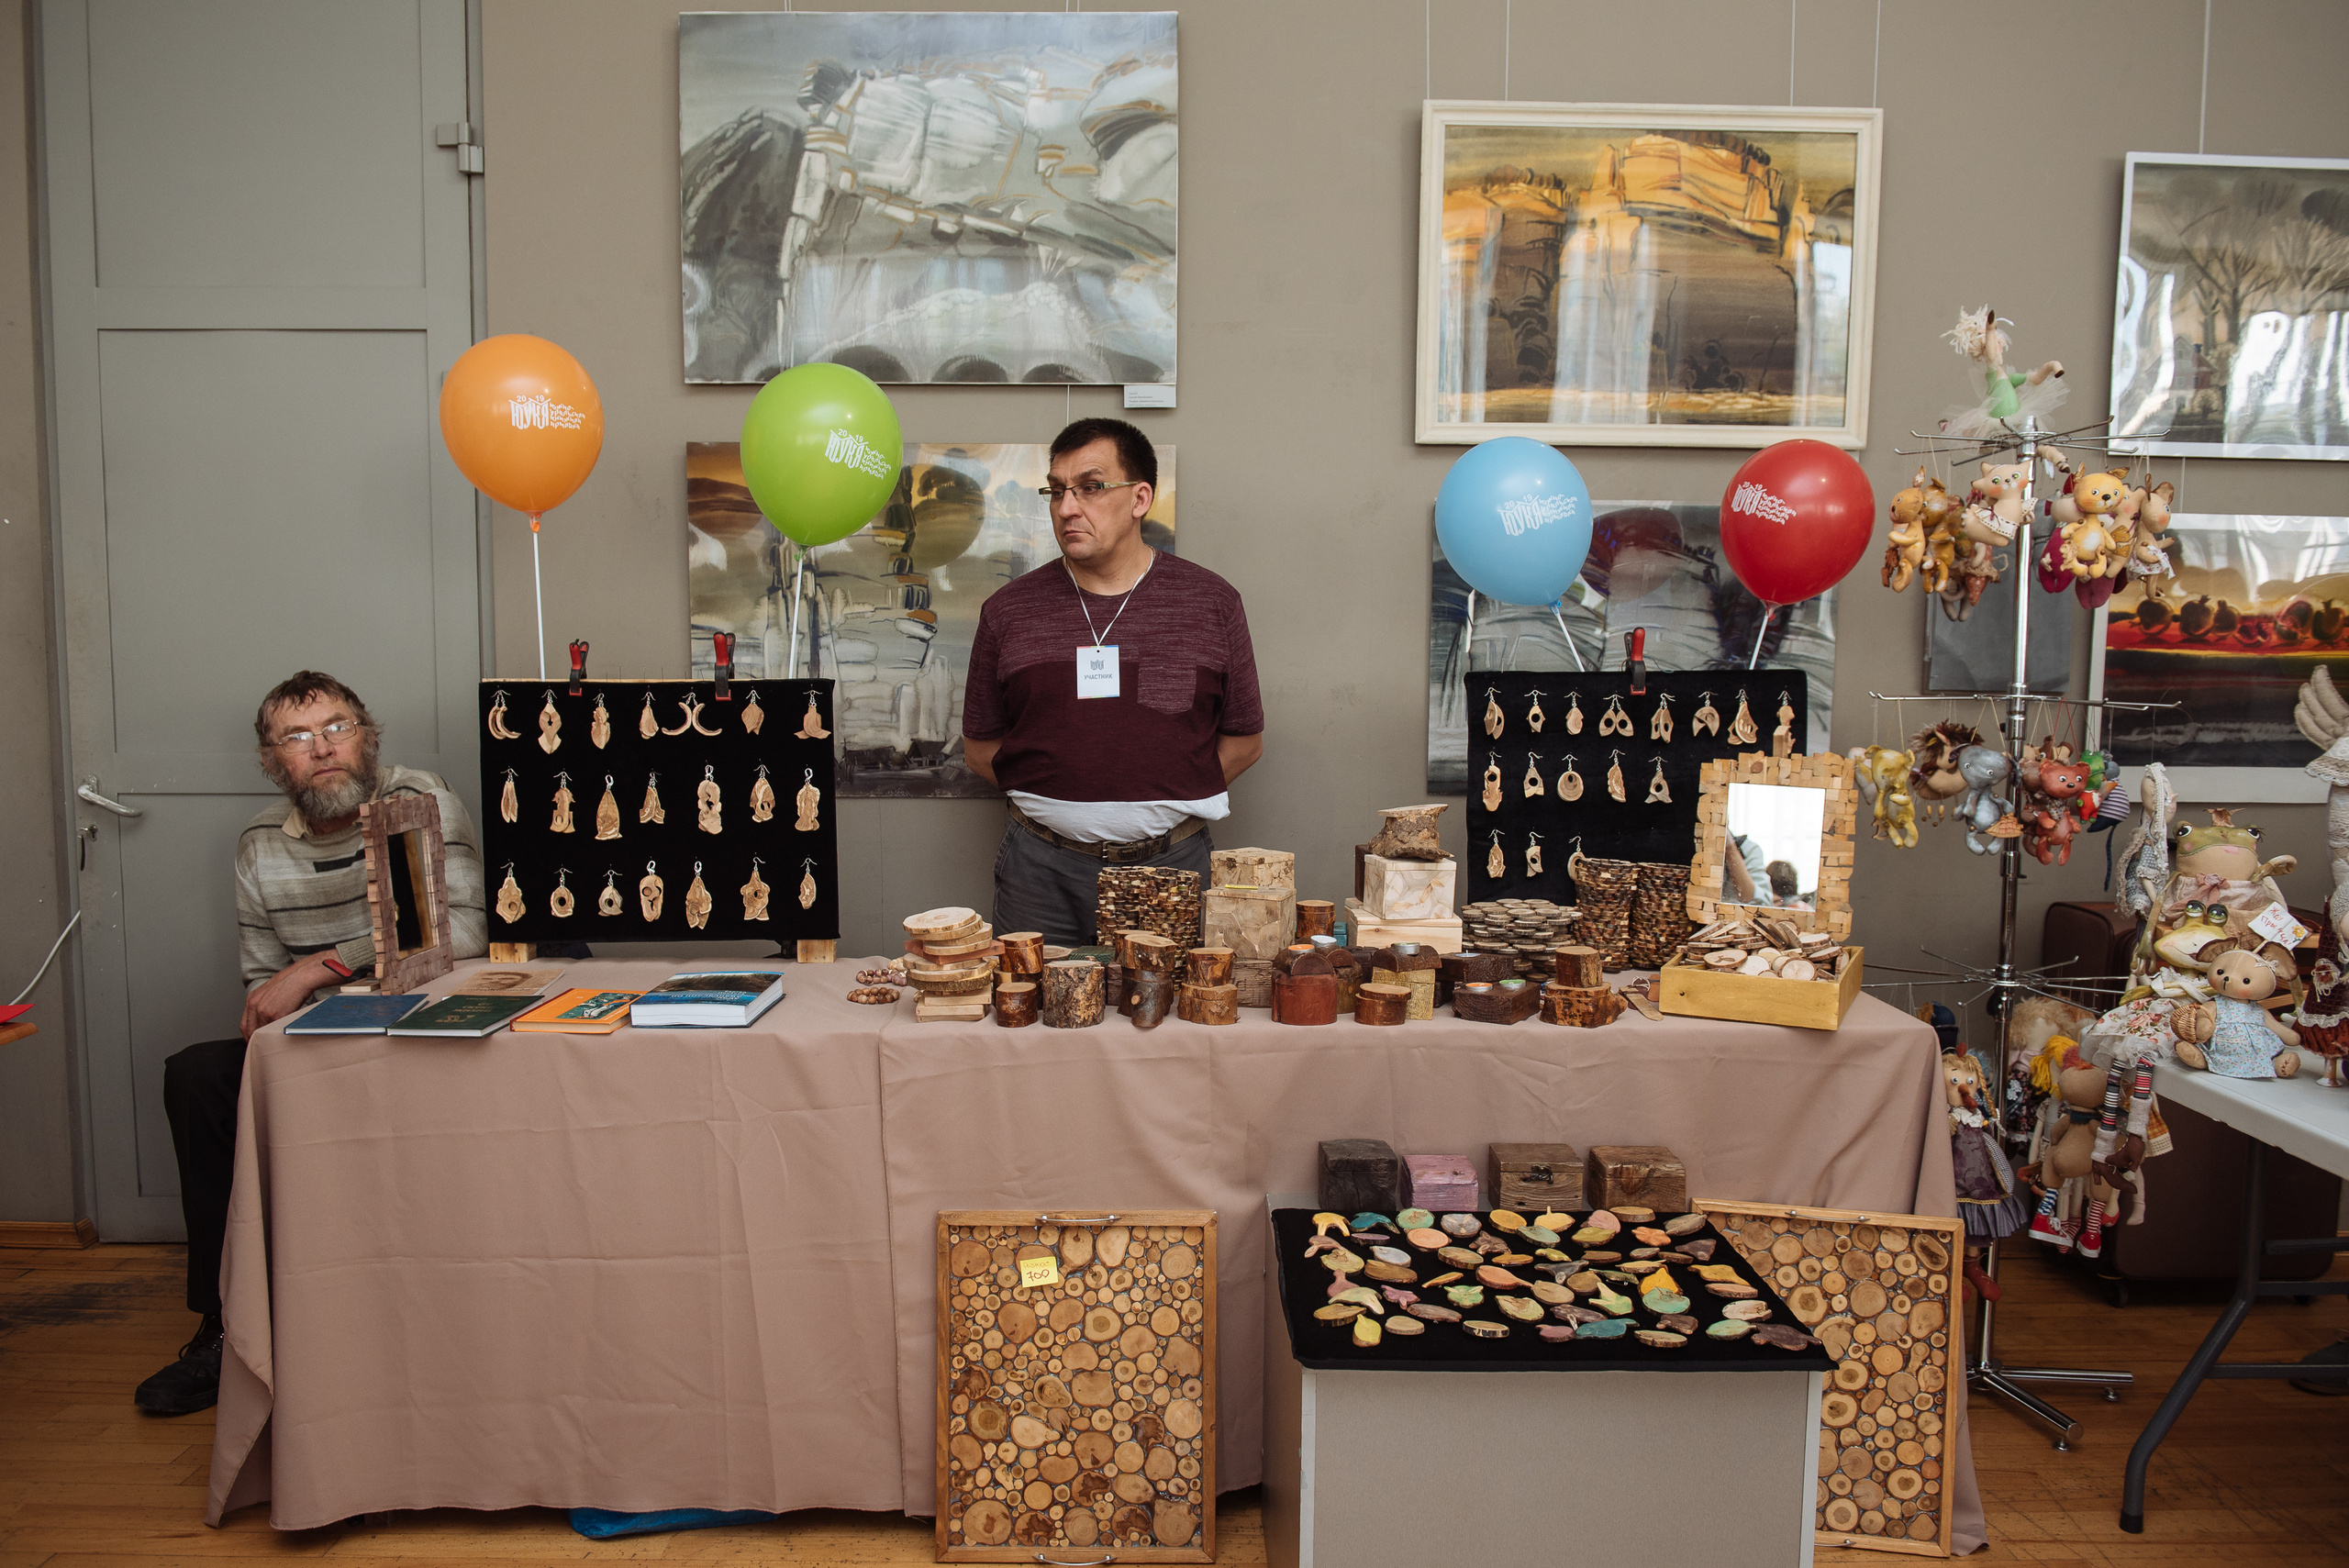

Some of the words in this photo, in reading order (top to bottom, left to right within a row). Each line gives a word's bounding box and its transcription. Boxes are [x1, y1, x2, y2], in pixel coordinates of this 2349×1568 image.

[517, 395, 527, 403] 20
[838, 428, 848, 437] 20
[855, 434, 863, 442] 19
[1026, 1268, 1051, 1282] 700
